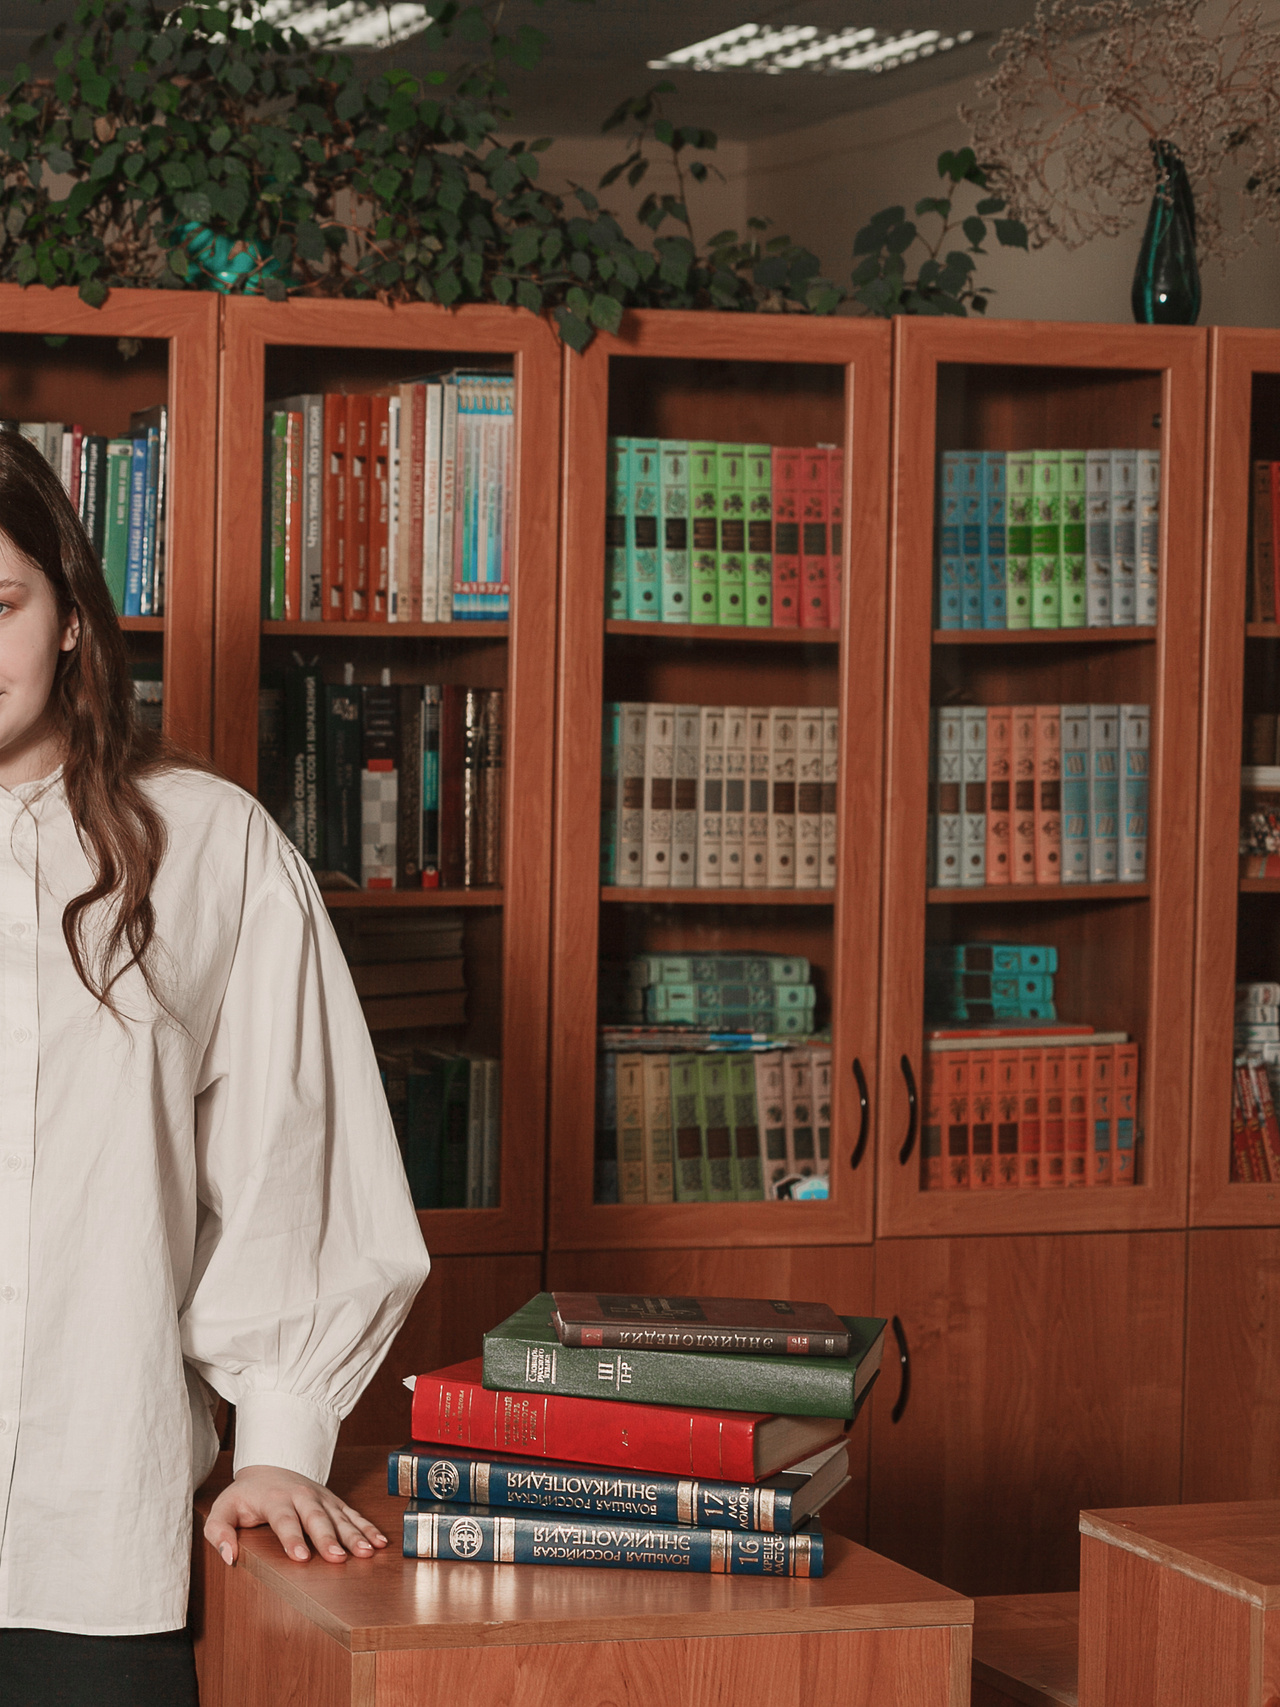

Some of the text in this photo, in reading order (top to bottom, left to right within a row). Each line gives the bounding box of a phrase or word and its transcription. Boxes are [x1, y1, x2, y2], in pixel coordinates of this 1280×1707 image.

[307, 405, 319, 548] Что такое Кто такой
[445, 459, 454, 513] НАУКА
[309, 574, 321, 610] Том 1
[293, 752, 306, 799] СЛОВАРЬ
[304, 675, 317, 860] ИНОСТРАННЫХ СЛОВ И ВЫРАЖЕНИЙ
[617, 1330, 774, 1350] ЭНЦИКЛОПЕДИЯ
[529, 1347, 538, 1382] Словарь
[537, 1348, 545, 1383] русского
[543, 1354, 551, 1379] языка
[444, 1392, 452, 1418] ОЖЕГОВ
[504, 1396, 513, 1446] ТОЛКОВЫЙ
[512, 1402, 521, 1442] СЛОВАРЬ
[521, 1400, 530, 1446] РУССКОГО
[529, 1410, 538, 1441] ЯЗЫКА
[506, 1472, 658, 1501] ЭНЦИКЛОПЕДИЯ
[506, 1492, 658, 1516] БОЛЬШАЯ РОССИЙСКАЯ
[703, 1489, 724, 1517] 17
[728, 1495, 738, 1519] ЛАС
[739, 1486, 750, 1529] ЛОМОН
[532, 1526, 691, 1550] ЭНЦИКЛОПЕДИЯ
[532, 1545, 691, 1566] БОЛЬШАЯ РОССИЙСКАЯ
[738, 1539, 760, 1565] 16
[763, 1536, 775, 1572] КРЕЩЕ
